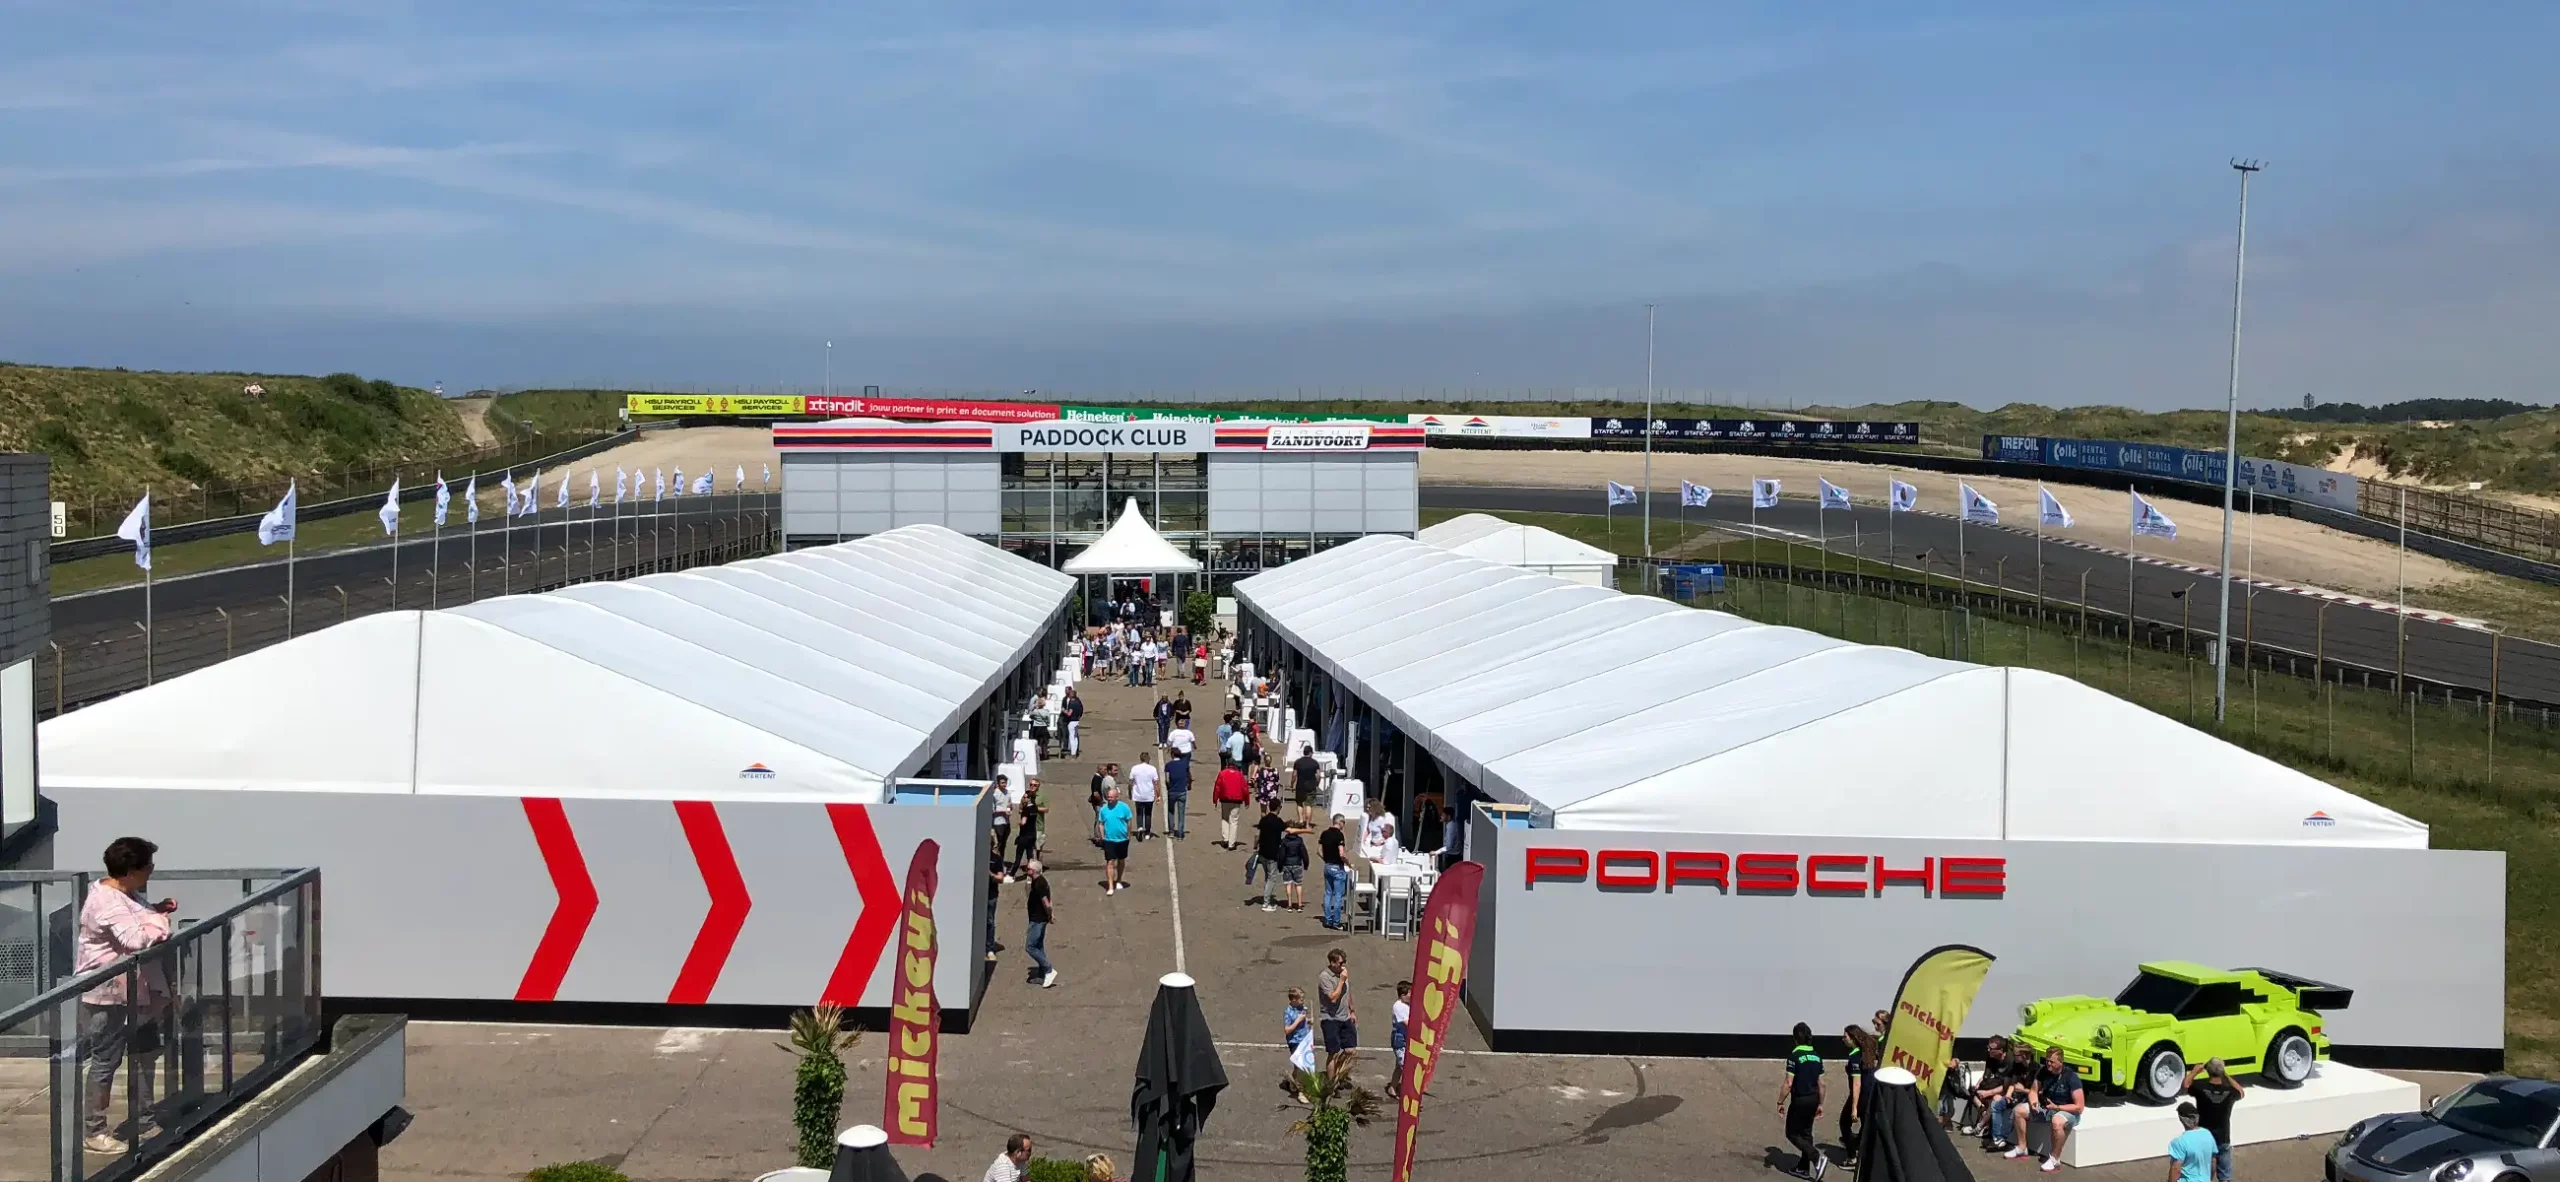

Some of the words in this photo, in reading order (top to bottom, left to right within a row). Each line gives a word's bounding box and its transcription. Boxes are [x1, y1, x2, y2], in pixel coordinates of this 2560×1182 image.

[809, 398, 865, 412] xtandit
[869, 403, 890, 412] jouw
[892, 404, 924, 414] partner
[936, 406, 957, 415] print
[972, 406, 1015, 417] document
[1017, 409, 1056, 419] solutions
[1067, 410, 1124, 423] Heineken
[1021, 430, 1124, 446] PADDOCK
[1131, 429, 1186, 446] CLUB
[1272, 436, 1364, 446] ZANDVOORT
[2001, 437, 2039, 450] TREFOIL
[2054, 442, 2077, 460] Collé
[2082, 445, 2107, 454] RENTAL
[2119, 446, 2142, 466] Collé
[2148, 451, 2171, 461] RENTAL
[2087, 456, 2107, 465] SALES
[2152, 463, 2171, 472] SALES
[54, 515, 63, 535] 50
[1346, 793, 1360, 804] 70
[1526, 847, 2006, 894] PORSCHE
